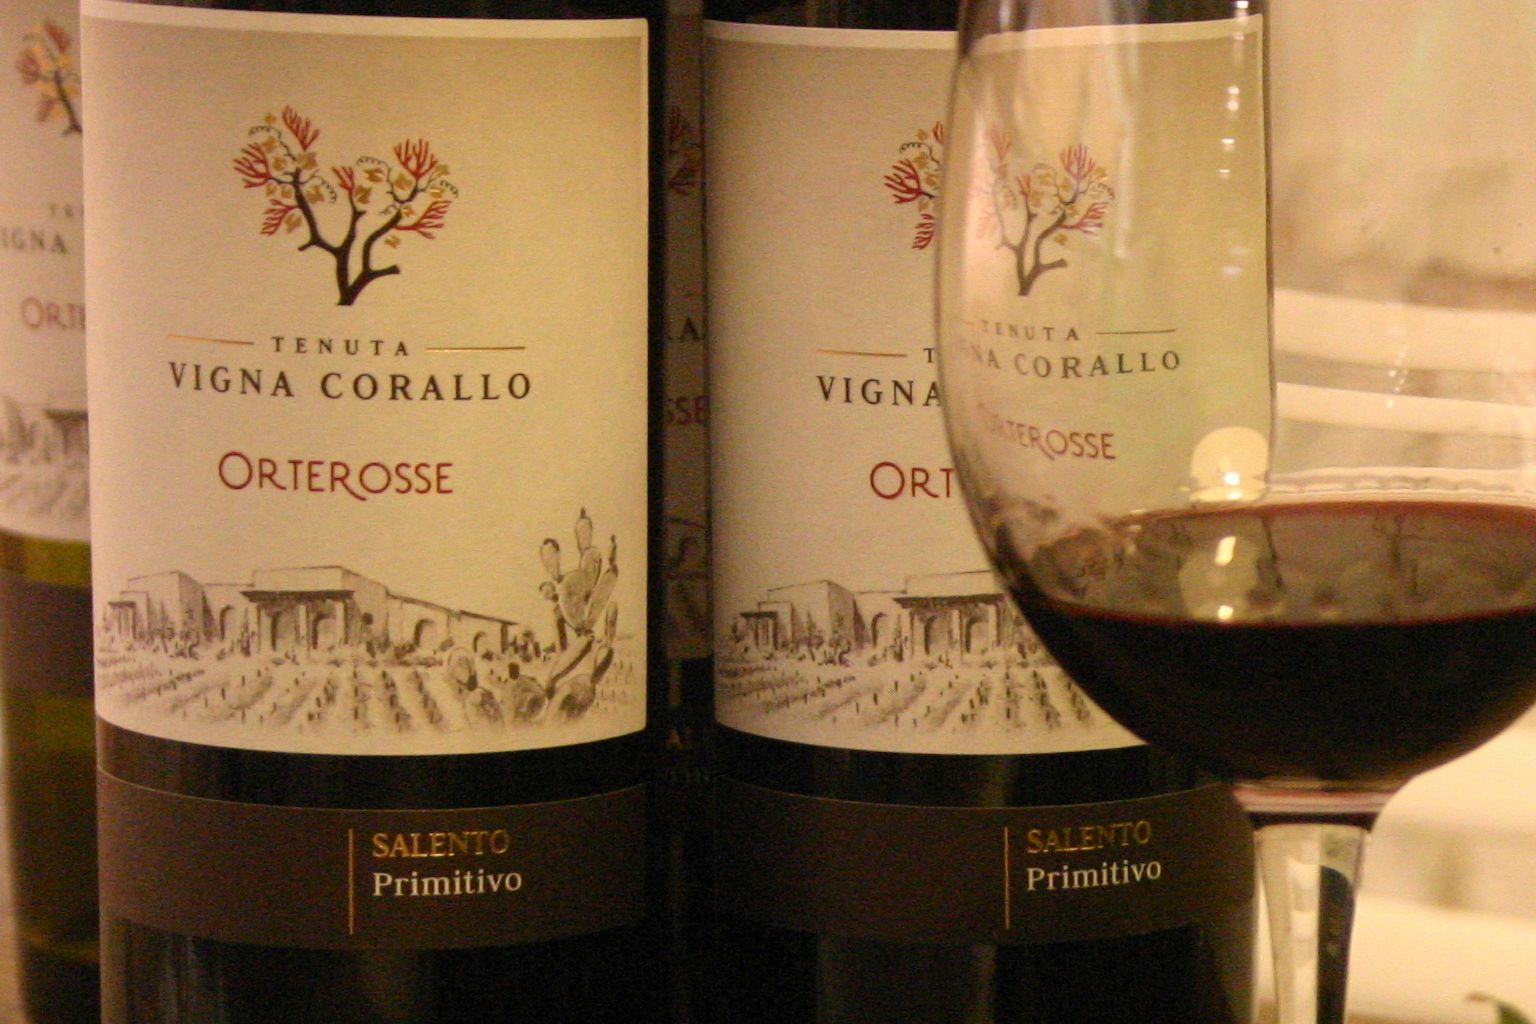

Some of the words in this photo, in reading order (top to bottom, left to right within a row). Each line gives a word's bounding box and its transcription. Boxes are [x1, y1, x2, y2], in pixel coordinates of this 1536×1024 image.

[272, 336, 409, 356] TENUTA
[981, 319, 1080, 342] TENUTA
[1014, 350, 1180, 379] CORALLO
[169, 361, 295, 397] VIGNA
[320, 372, 531, 401] CORALLO
[816, 375, 944, 407] VIGNA
[218, 450, 454, 501] ORTEROSSE
[371, 829, 512, 859] SALENTO
[1026, 820, 1152, 854] SALENTO
[372, 868, 523, 897] Primitivo
[1027, 859, 1162, 892] Primitivo
